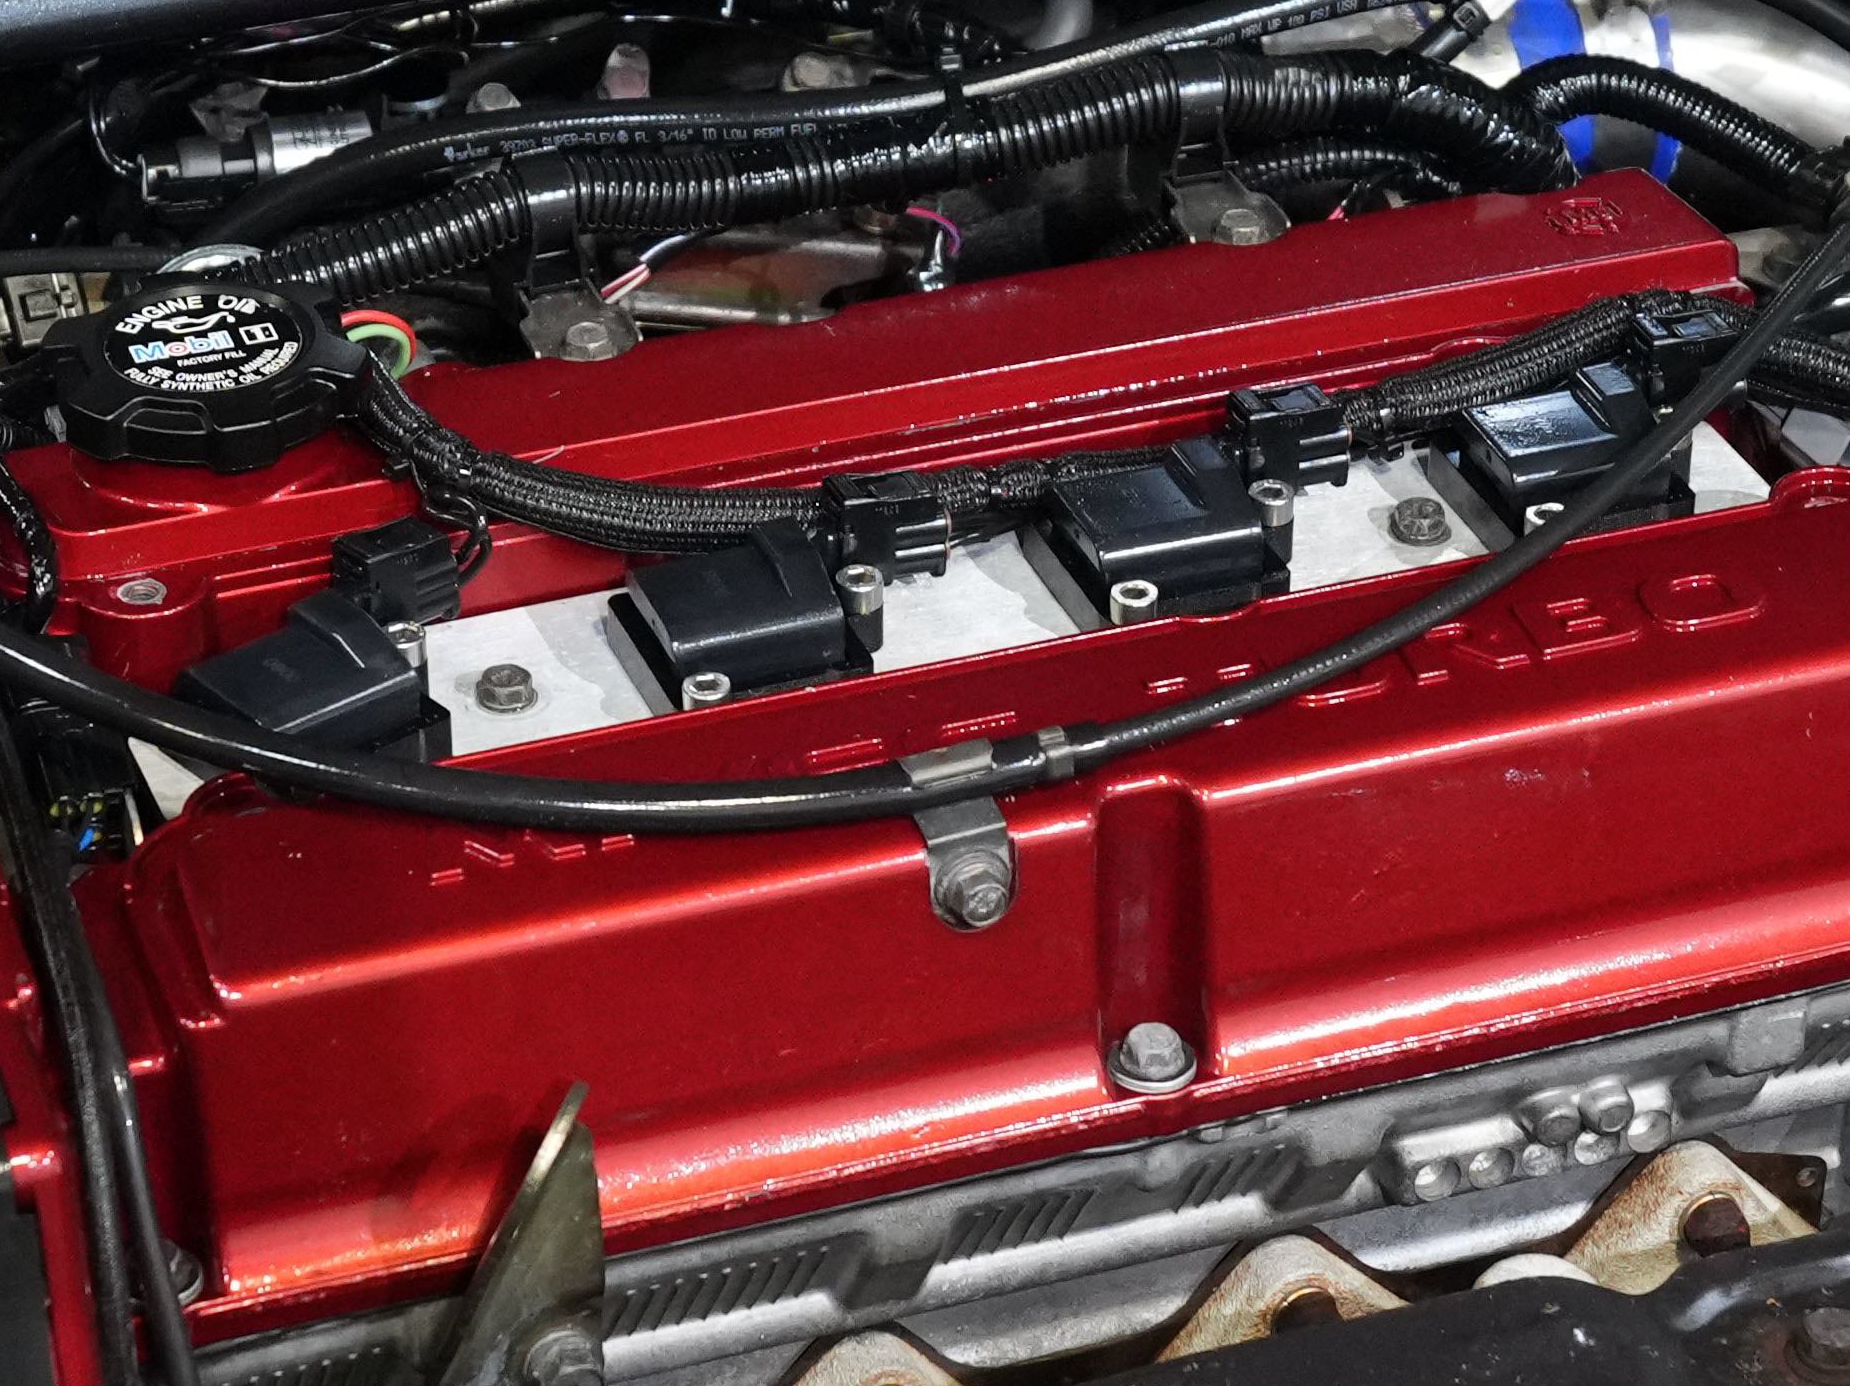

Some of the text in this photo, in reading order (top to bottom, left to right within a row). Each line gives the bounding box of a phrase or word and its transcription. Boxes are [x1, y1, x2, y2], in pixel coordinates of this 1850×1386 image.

[1310, 7, 1331, 21] PSI
[752, 125, 786, 140] PERM
[115, 295, 204, 334] ENGINE
[176, 349, 247, 368] FACTORY FILL
[124, 366, 160, 386] FULLY
[160, 378, 236, 392] SYNTHETIC
[239, 371, 262, 384] OIL
[175, 367, 237, 383] OWNER'S
